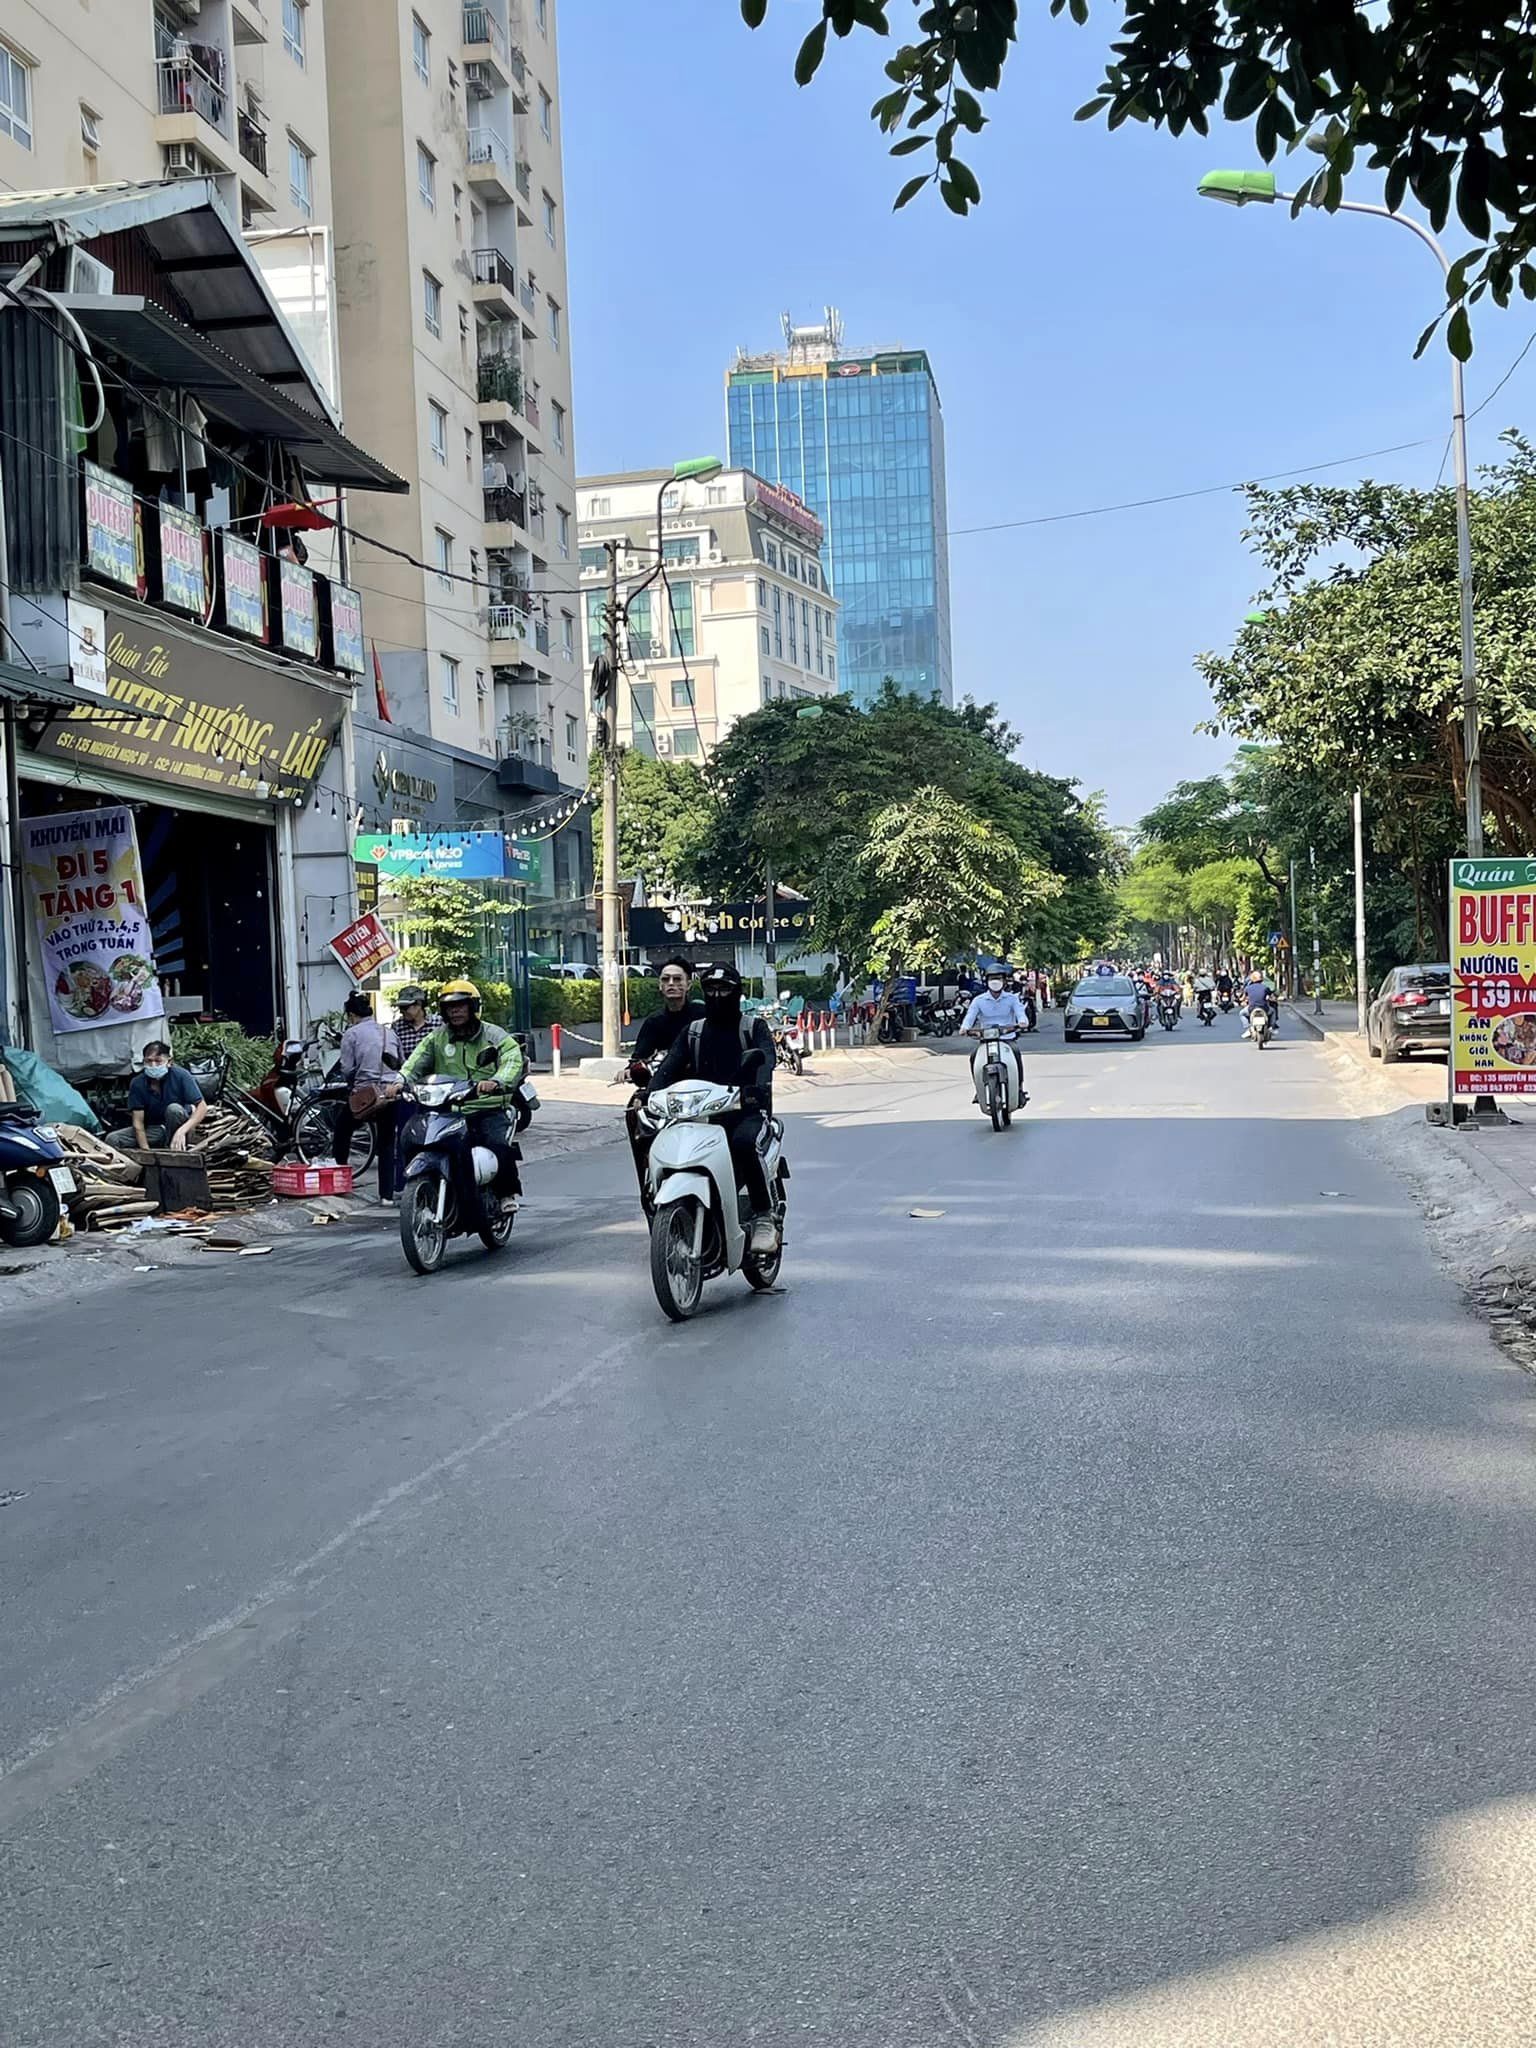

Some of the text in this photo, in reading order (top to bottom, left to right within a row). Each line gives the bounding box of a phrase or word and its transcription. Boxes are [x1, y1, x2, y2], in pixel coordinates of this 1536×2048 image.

[170, 703, 274, 766] NƯỚNG
[279, 718, 327, 779] LẨU
[95, 816, 125, 838] MẠI
[57, 849, 108, 880] ĐI 5
[1458, 863, 1516, 887] Quán
[39, 880, 136, 922] TẶNG 1
[1459, 894, 1536, 944] BUFF
[46, 928, 71, 947] VÀO
[97, 920, 140, 934] 2,3,4,5
[56, 939, 97, 960] TRONG
[1460, 953, 1518, 974] NƯỚNG
[1467, 980, 1511, 1008] 139
